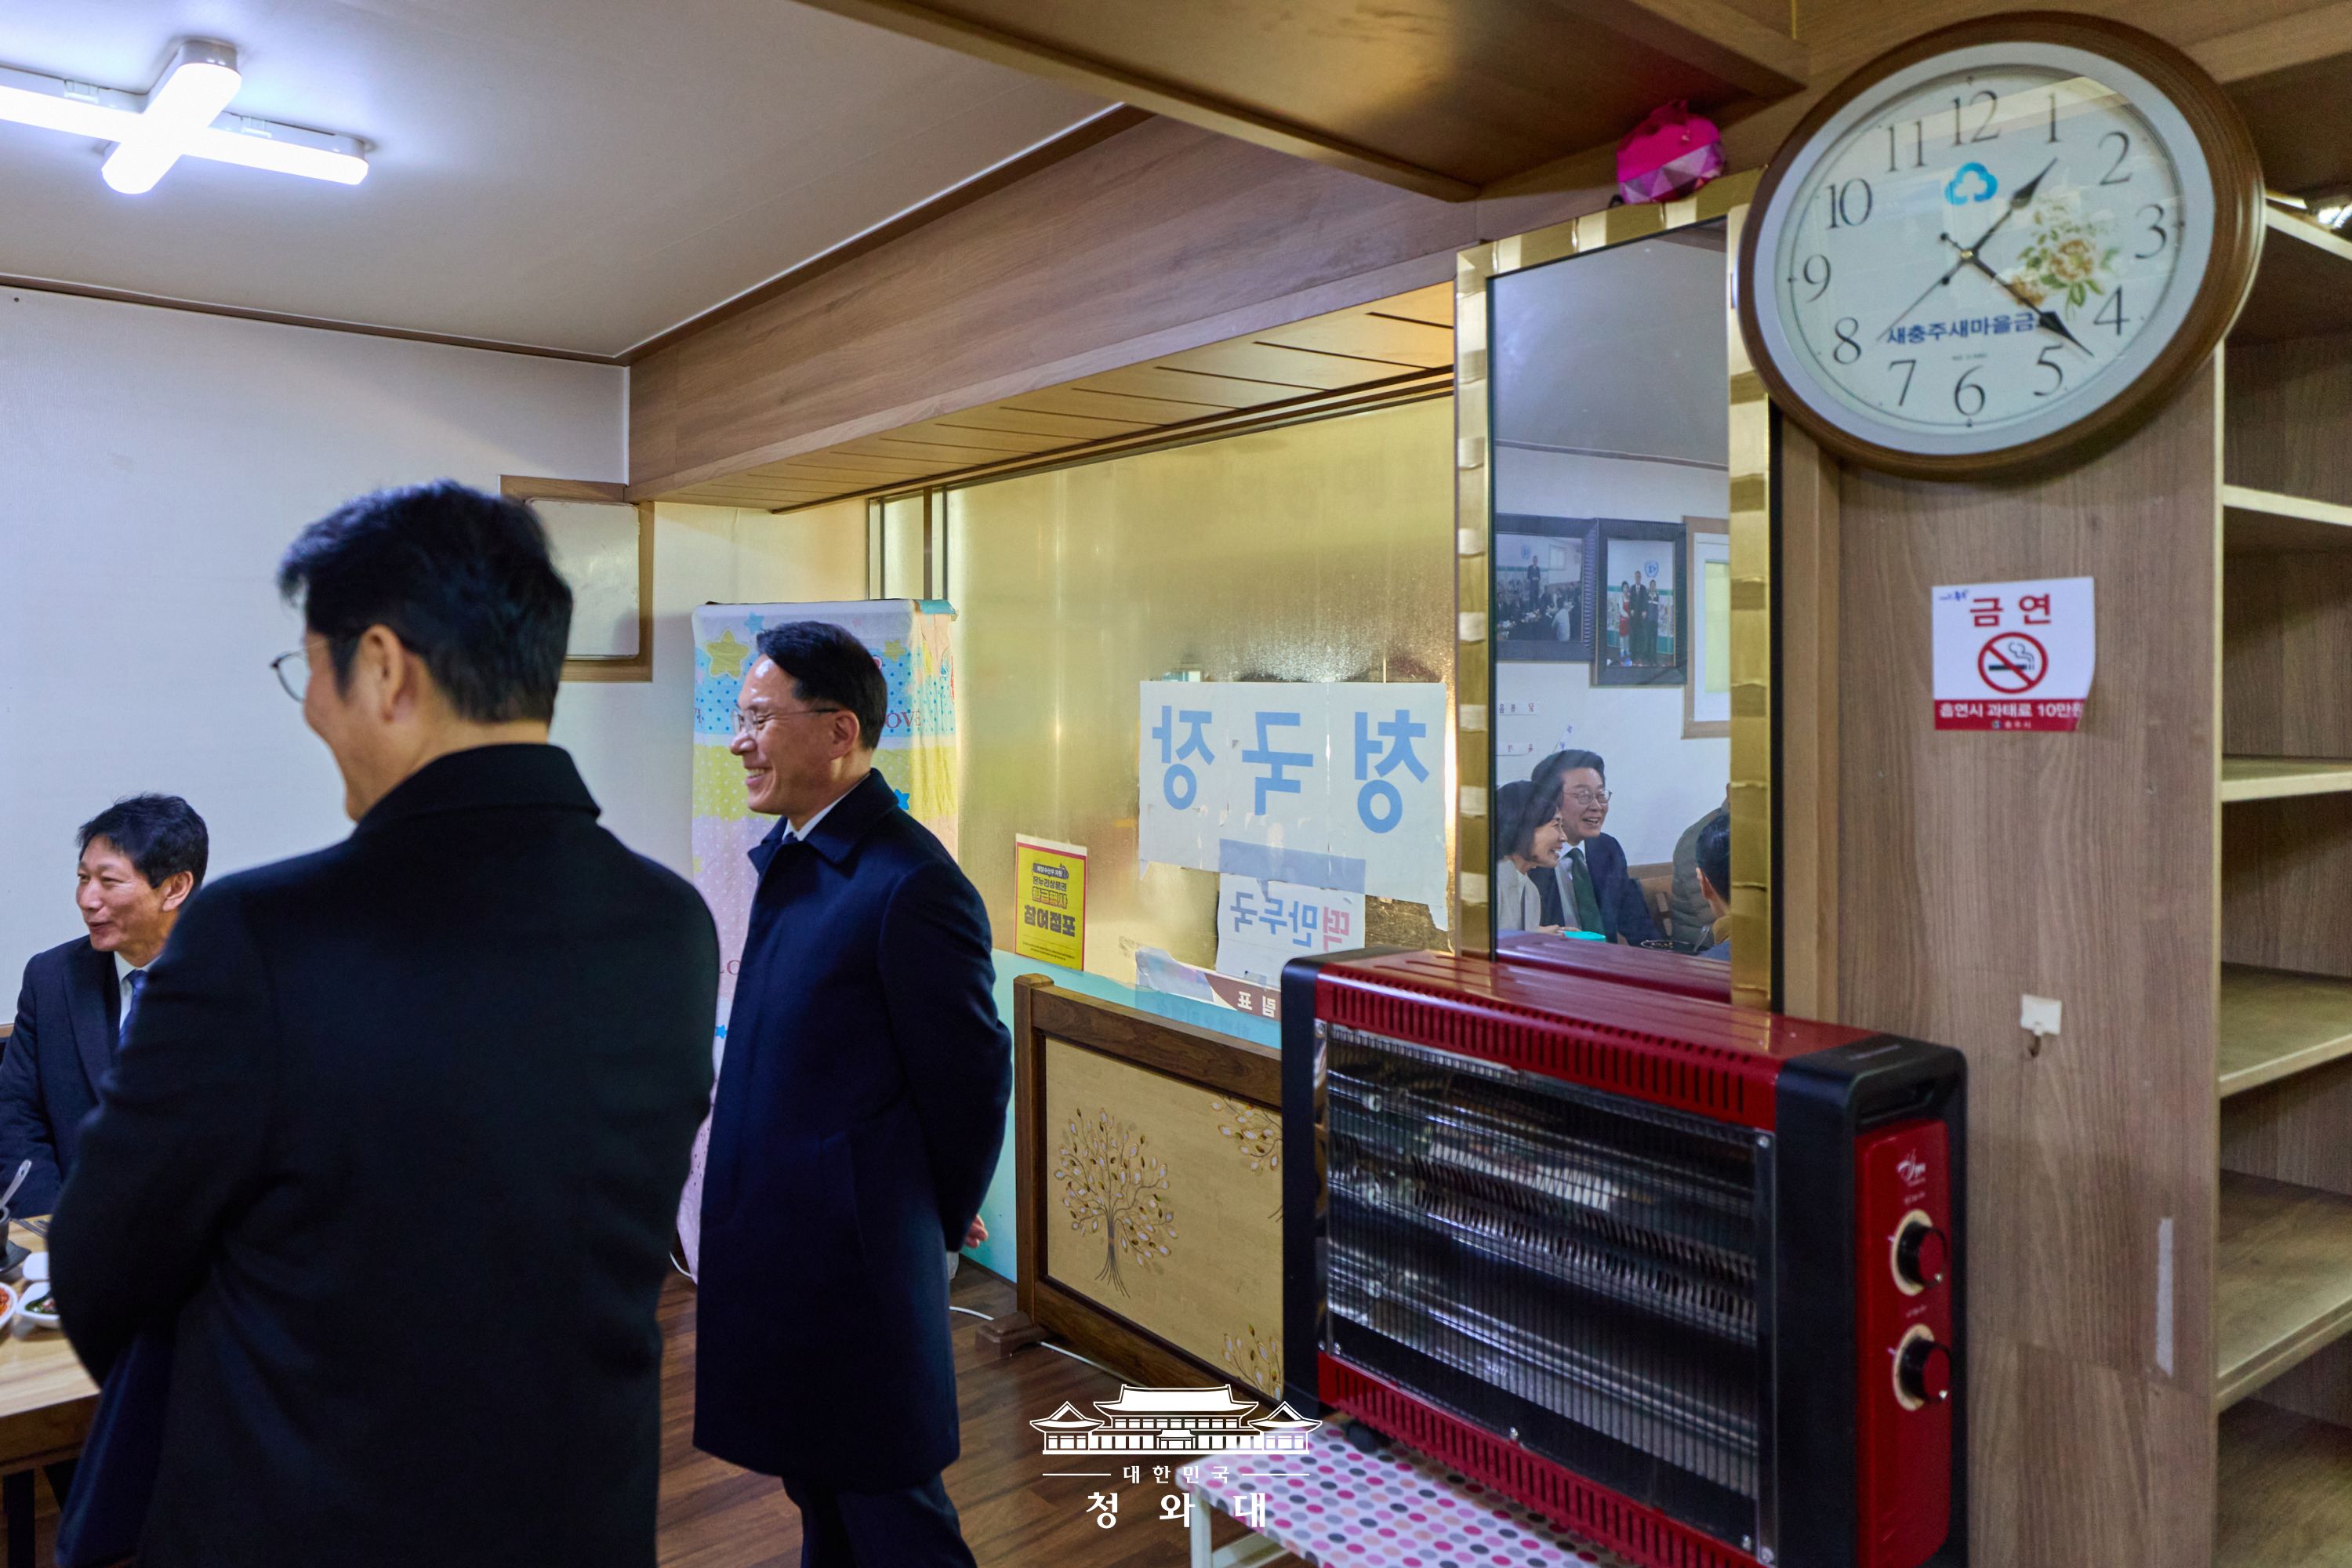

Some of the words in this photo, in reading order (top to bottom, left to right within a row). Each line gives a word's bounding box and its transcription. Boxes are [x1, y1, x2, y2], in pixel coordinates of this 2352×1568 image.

[1953, 90, 1999, 146] 12
[2046, 94, 2063, 143] 1
[1885, 120, 1926, 173] 11
[2097, 132, 2132, 186] 2
[1827, 178, 1872, 229] 10
[2135, 204, 2167, 260] 3
[1803, 254, 1831, 303] 9
[1887, 311, 2046, 345] 새충주새마을금
[2093, 285, 2129, 337] 4
[1832, 317, 1861, 365] 8
[1888, 359, 1917, 406] 7
[1955, 365, 1986, 416] 6
[2033, 345, 2063, 396] 5
[1969, 593, 2052, 627] 금연
[884, 709, 921, 728] OVE
[1025, 904, 1076, 938] 참여점포
